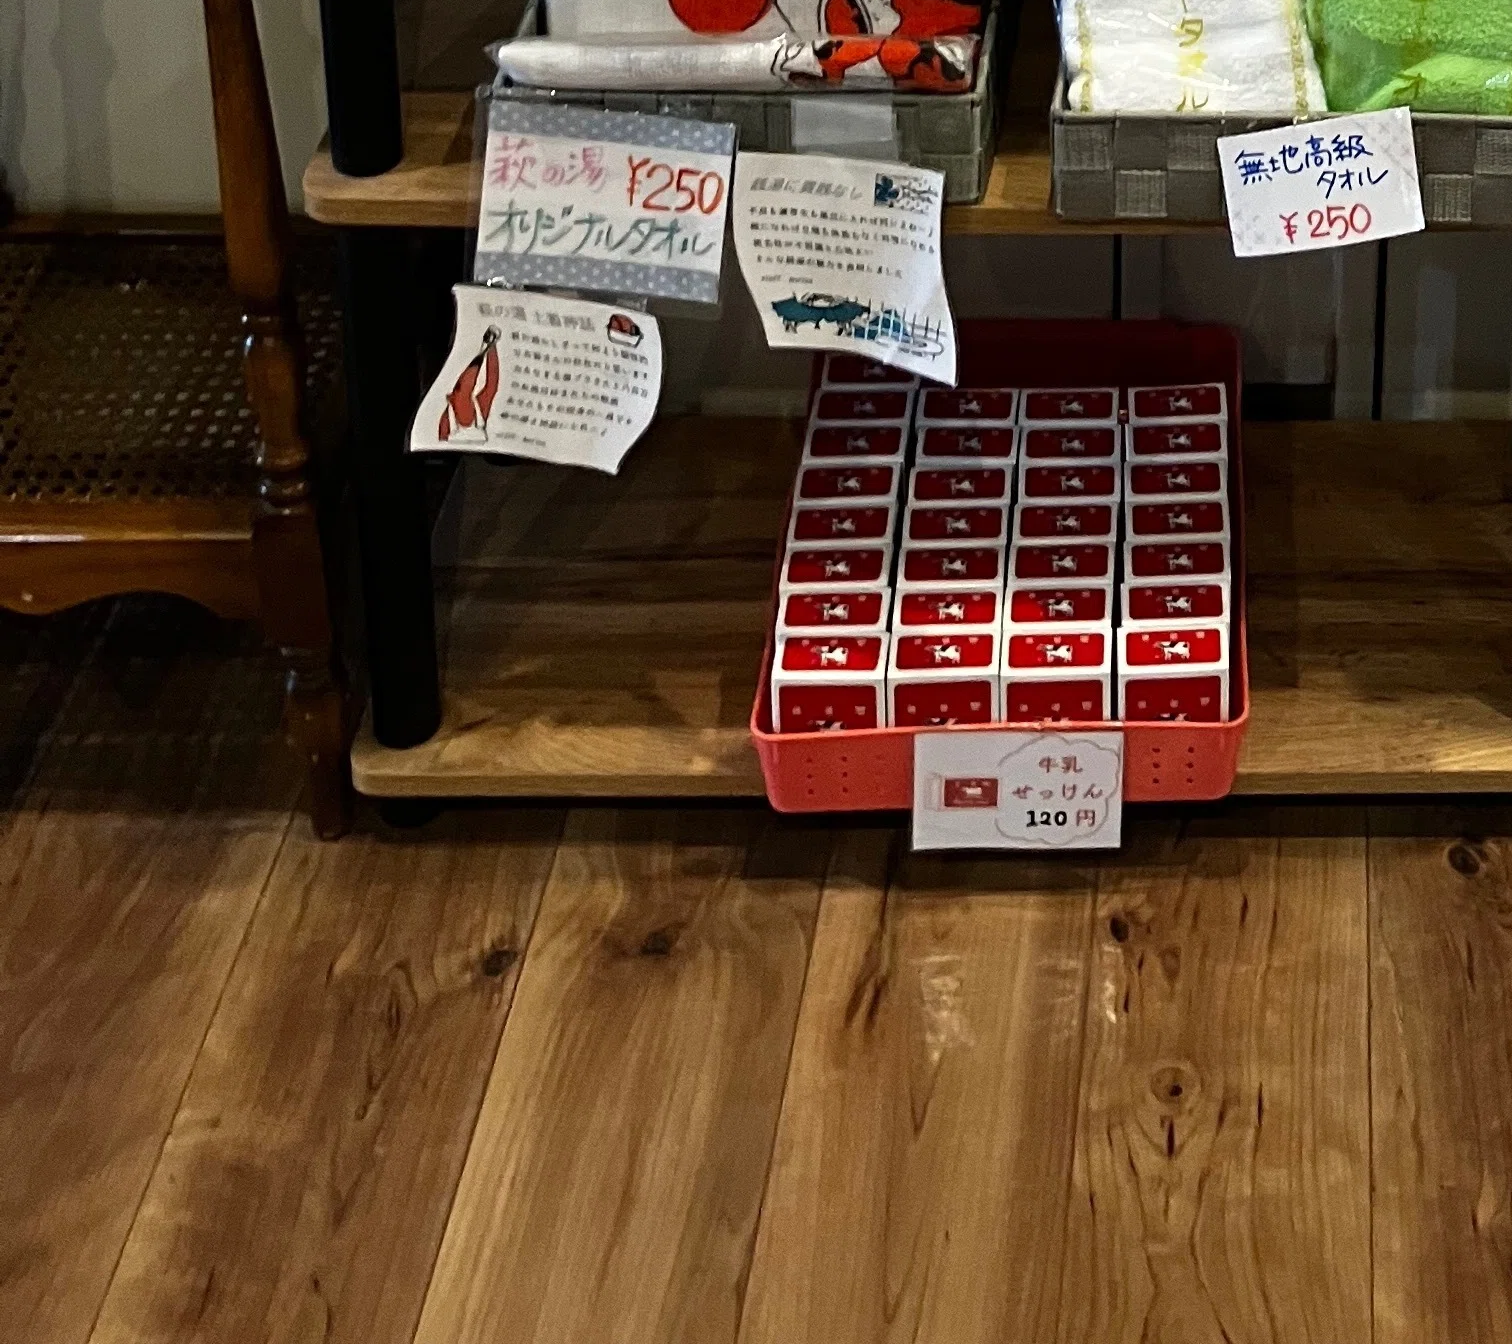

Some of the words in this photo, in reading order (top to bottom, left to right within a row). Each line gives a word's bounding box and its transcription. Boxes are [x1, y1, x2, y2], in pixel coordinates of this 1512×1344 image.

[488, 132, 609, 191] 萩の湯
[625, 153, 725, 216] ¥250
[1235, 135, 1374, 185] 無地高級
[1316, 165, 1391, 201] タオル
[484, 197, 717, 256] オリジナルタオル
[1280, 202, 1372, 245] ¥250
[1037, 755, 1085, 776] 牛乳
[1010, 783, 1105, 803] せっけん
[1025, 809, 1098, 829] 120円
